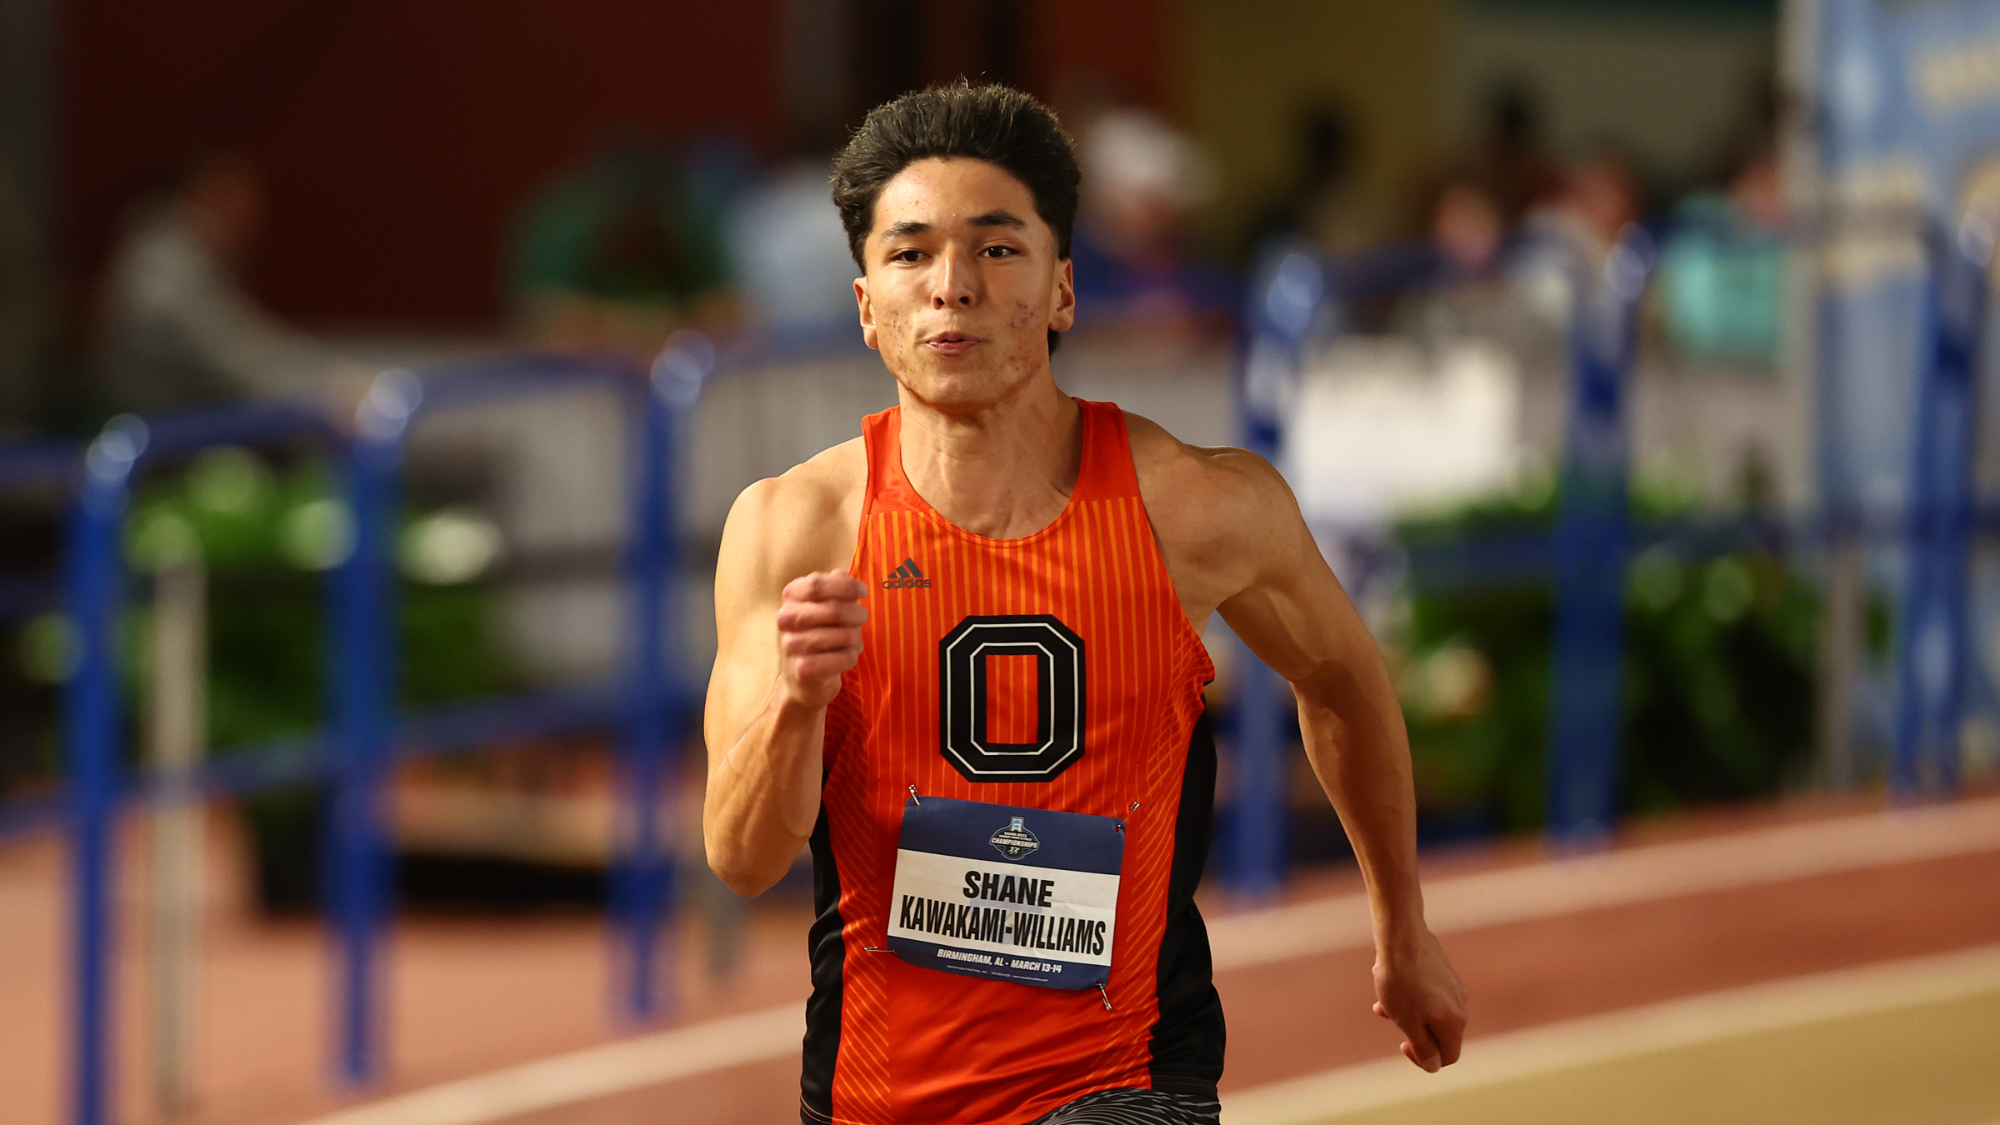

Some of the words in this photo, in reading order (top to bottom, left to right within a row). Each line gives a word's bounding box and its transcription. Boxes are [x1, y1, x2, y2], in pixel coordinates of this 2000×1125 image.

[882, 577, 932, 589] adidas
[991, 837, 1038, 849] CHAMPIONSHIPS
[963, 871, 1055, 907] SHANE
[899, 895, 1106, 955] KAWAKAMI-WILLIAMS
[937, 949, 992, 965] BIRMINGHAM,
[994, 957, 1004, 966] AL
[1010, 959, 1041, 971] MARCH
[1041, 963, 1062, 973] 13-14
